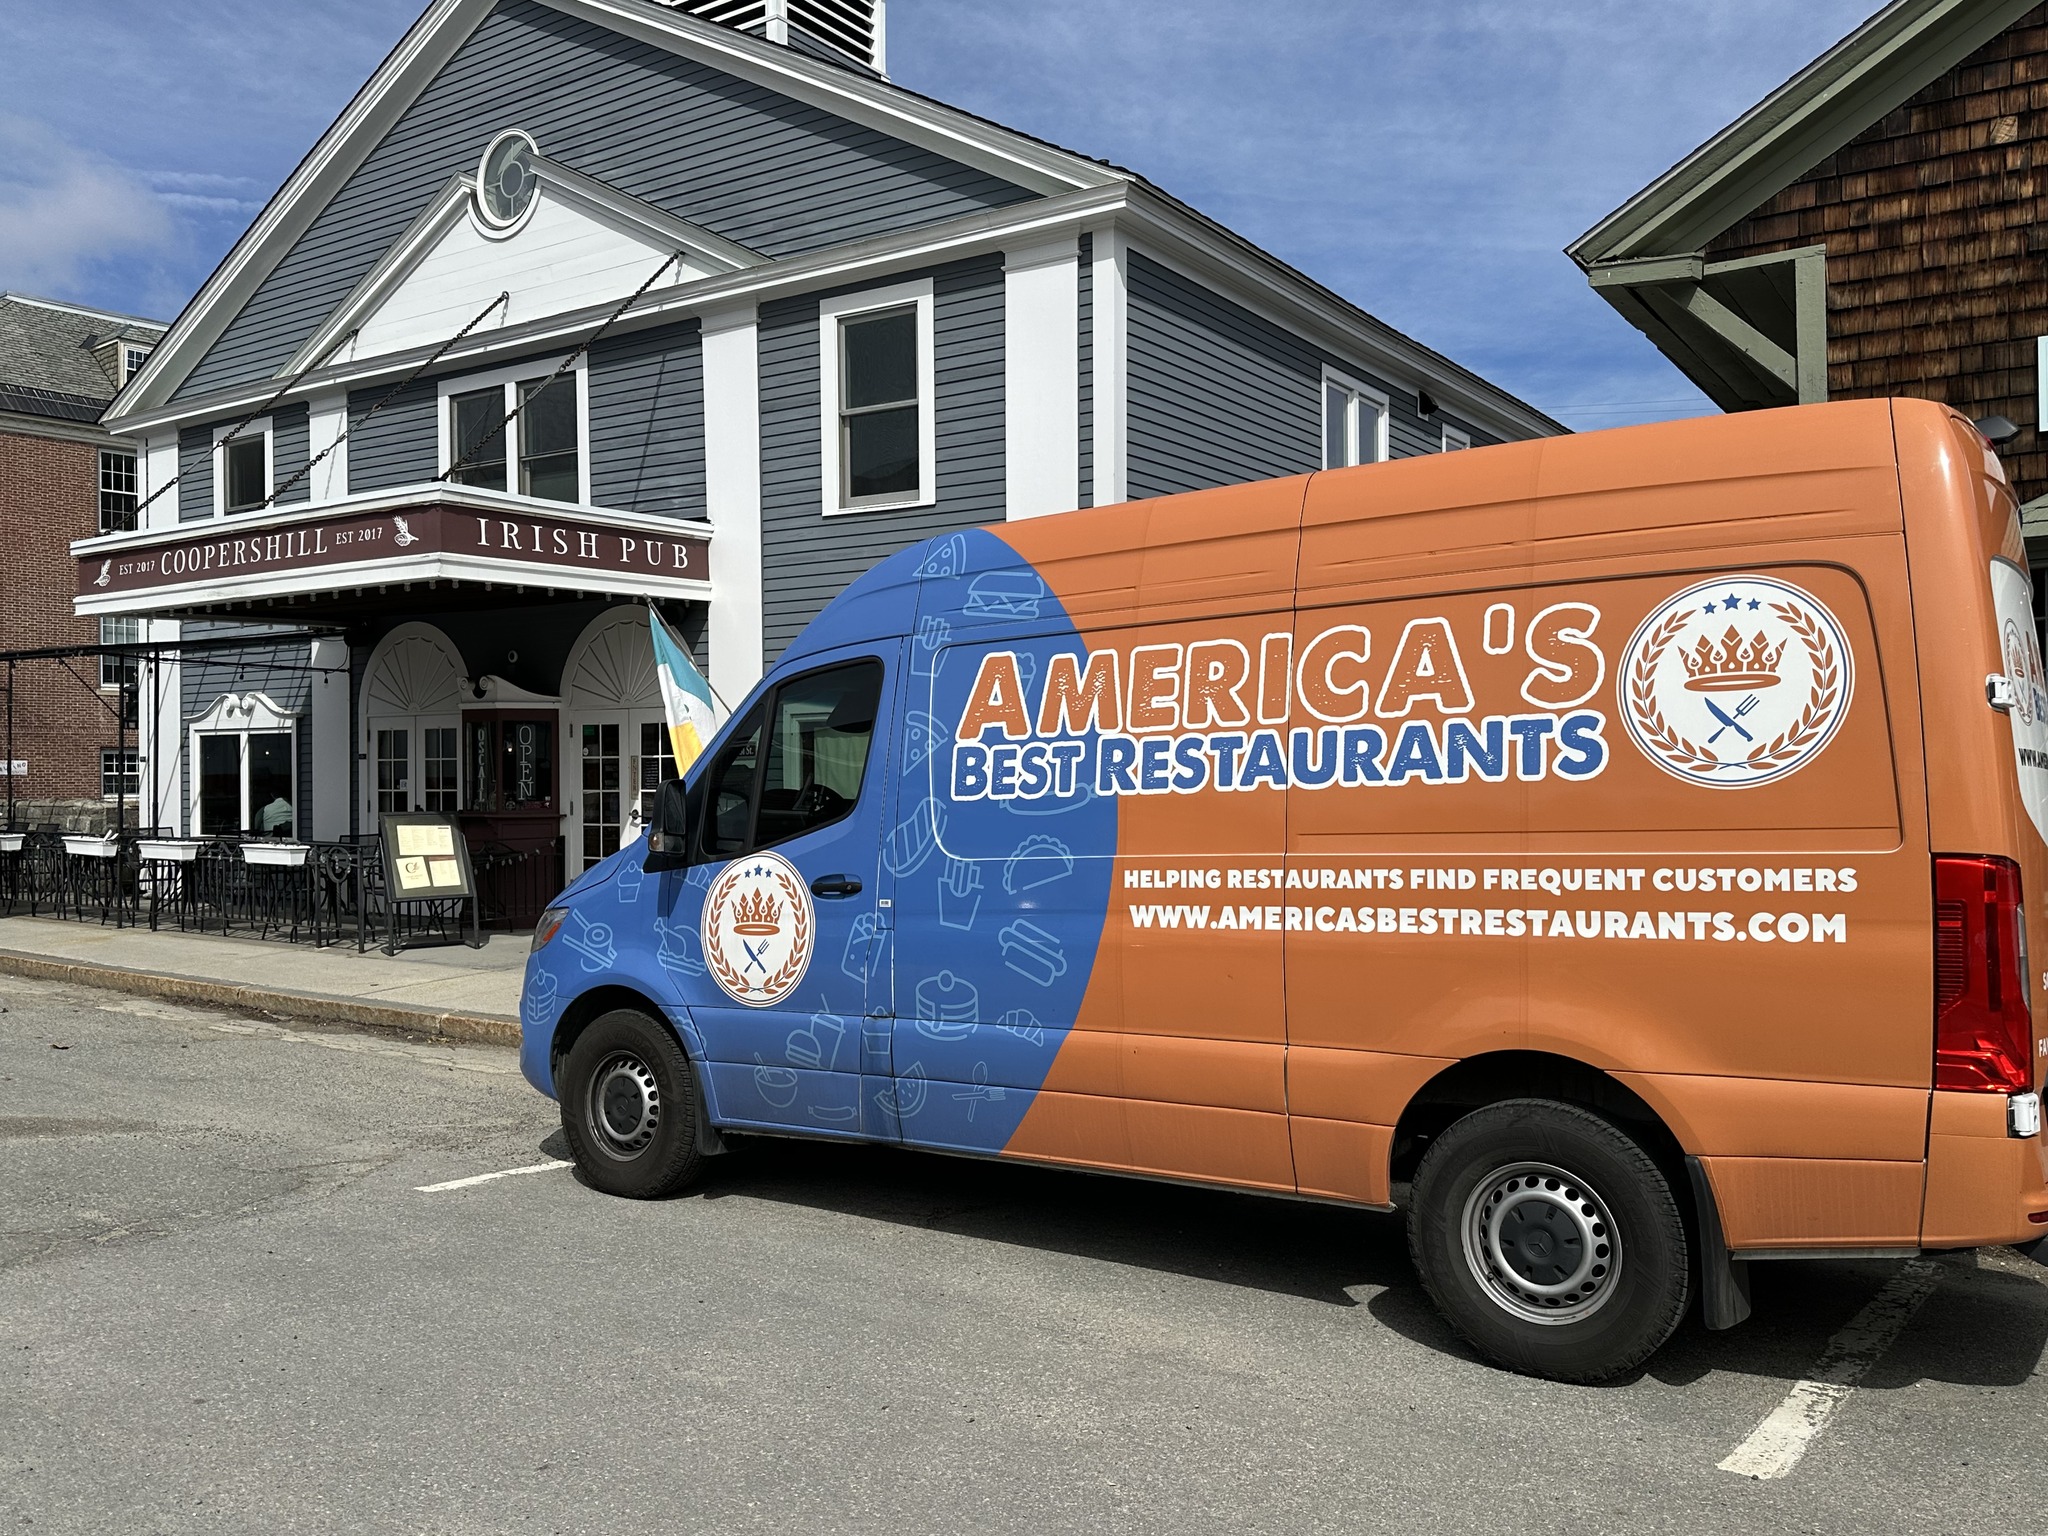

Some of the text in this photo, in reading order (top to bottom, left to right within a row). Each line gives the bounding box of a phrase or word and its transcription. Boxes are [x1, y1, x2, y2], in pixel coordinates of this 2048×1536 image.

[119, 527, 383, 576] EST 2017 COOPERSHILL EST 2017
[476, 517, 689, 569] IRISH PUB
[955, 602, 1606, 743] AMERICA'S
[517, 725, 534, 801] OPEN
[951, 711, 1610, 802] BEST RESTAURANTS
[1124, 867, 1858, 896] HELPING RESTAURANTS FIND FREQUENT CUSTOMERS
[1129, 905, 1847, 943] WWW.AMERICASBESTRESTAURANTS.COM
